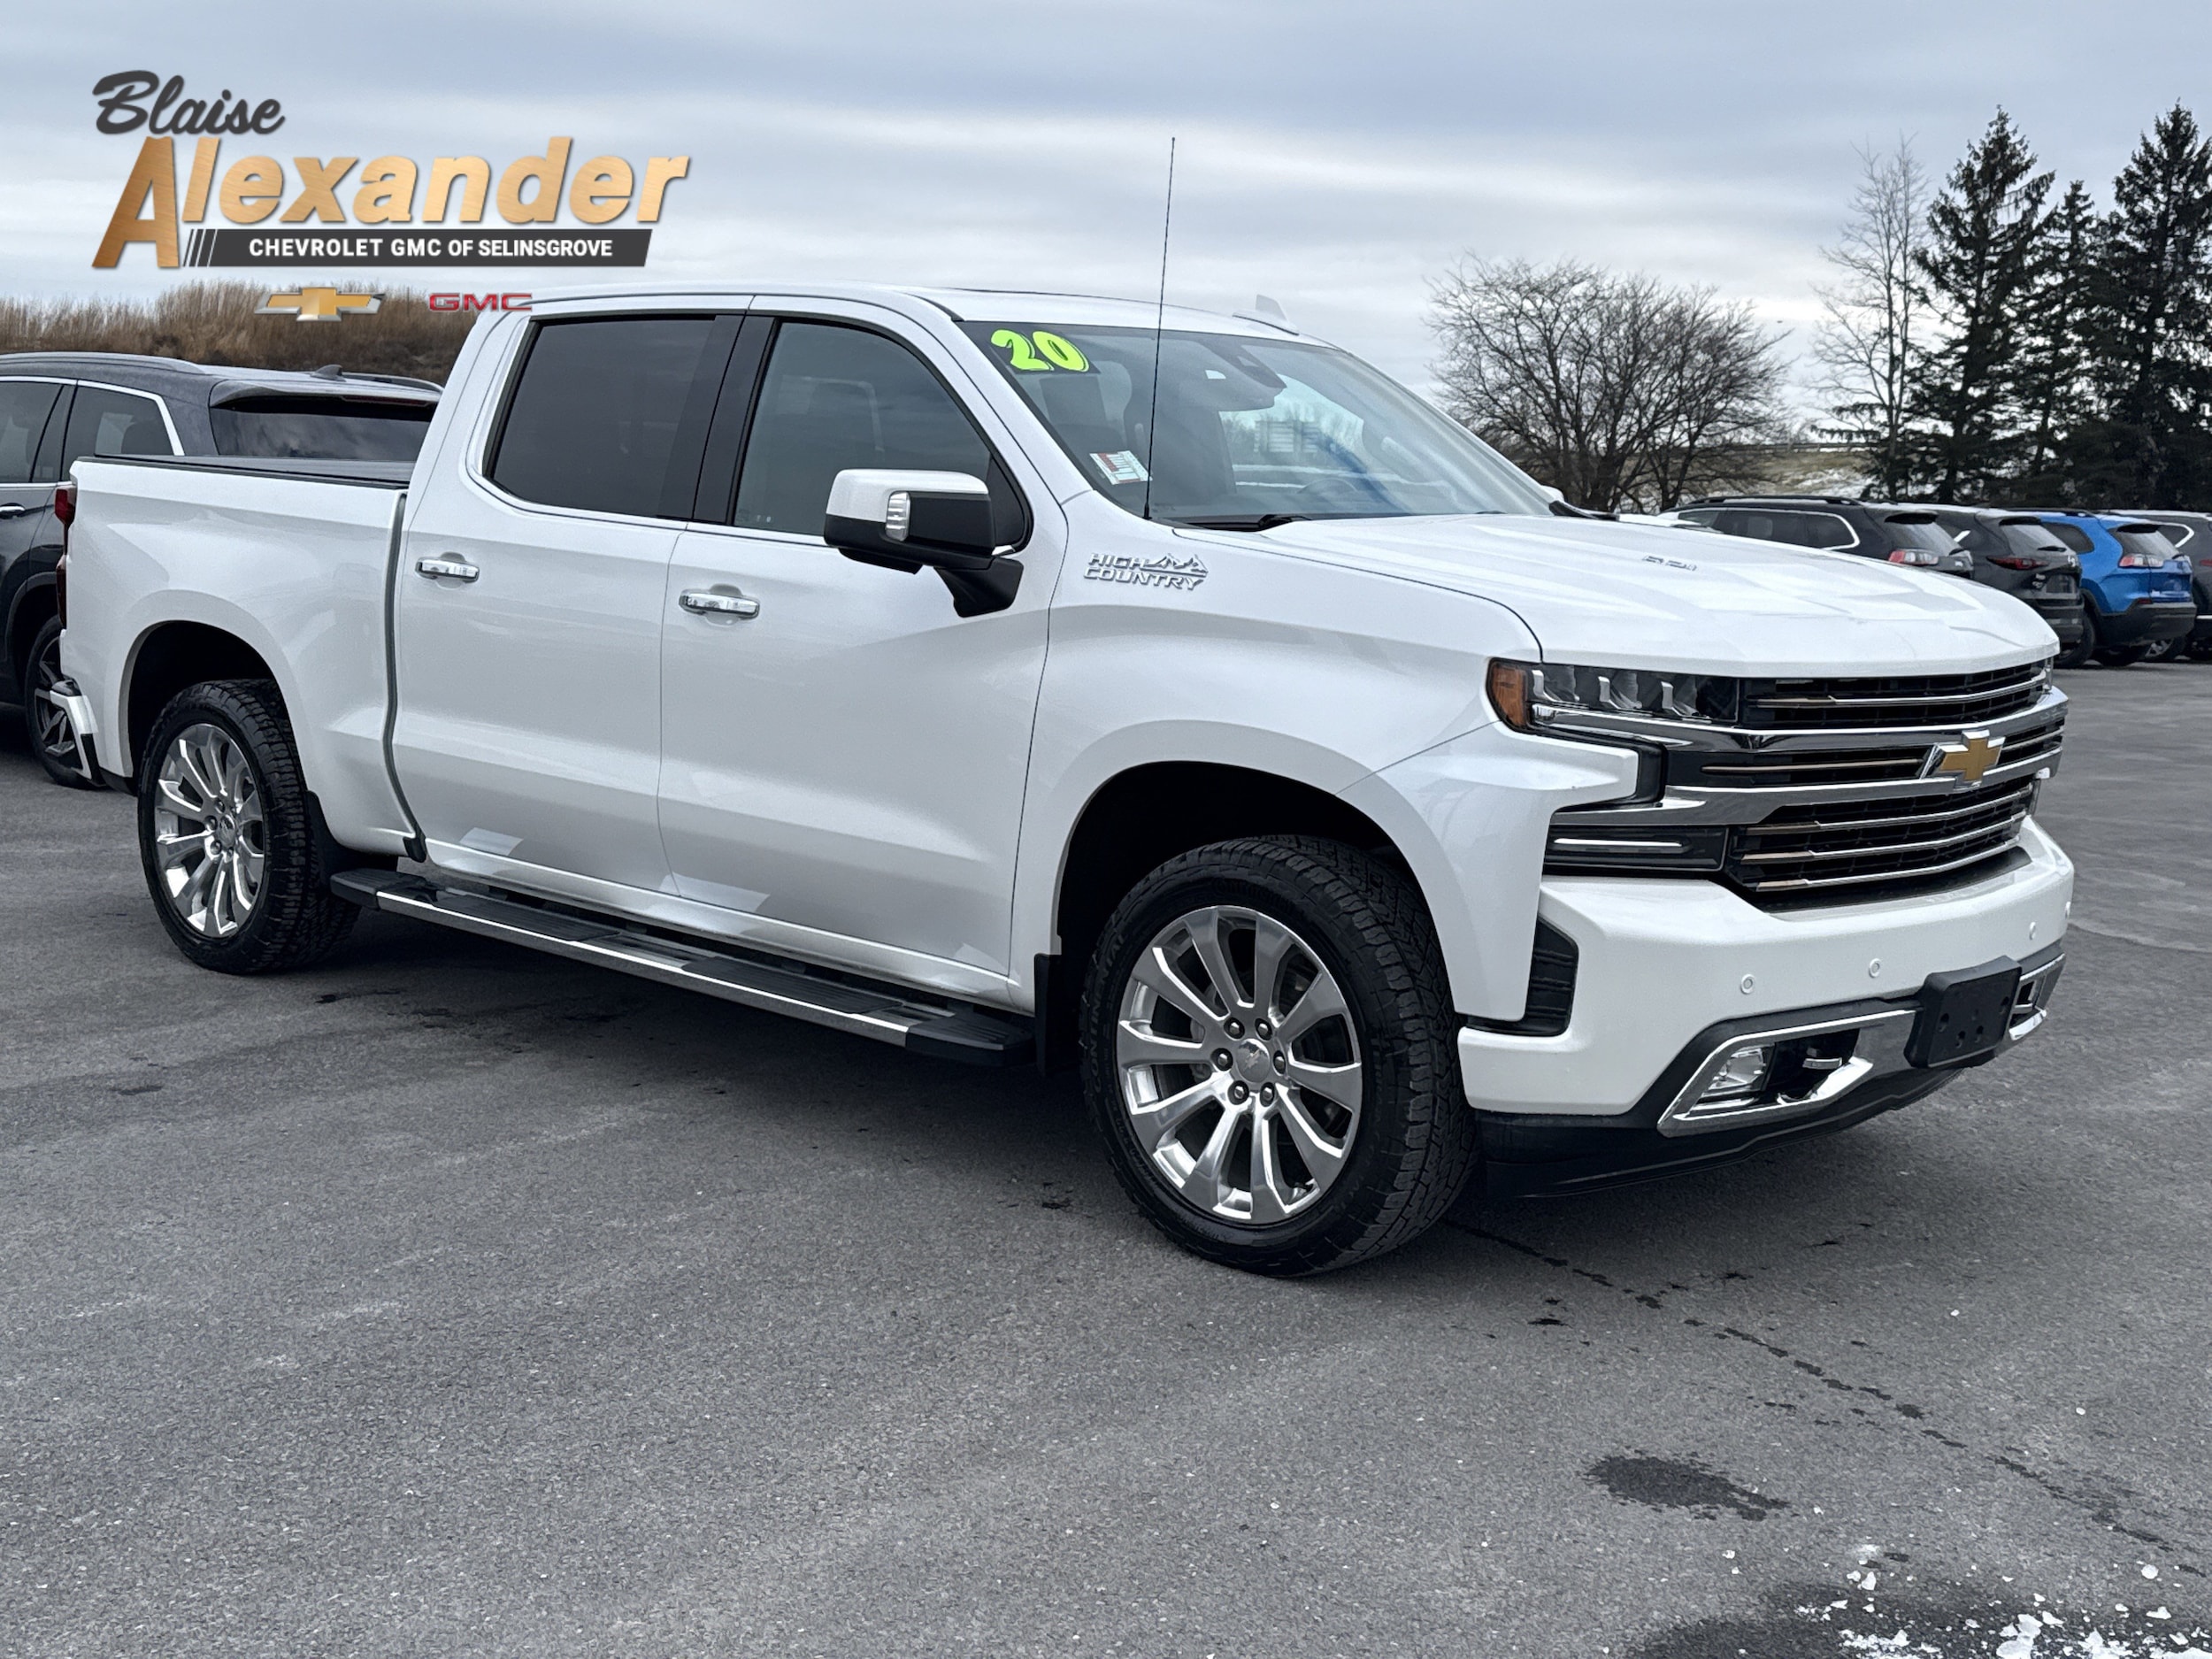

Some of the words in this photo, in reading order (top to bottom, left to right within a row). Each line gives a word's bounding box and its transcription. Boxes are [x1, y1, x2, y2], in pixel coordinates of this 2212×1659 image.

[990, 329, 1090, 373] 20
[1087, 553, 1150, 570] HIGH
[1084, 566, 1205, 591] COUNTRY
